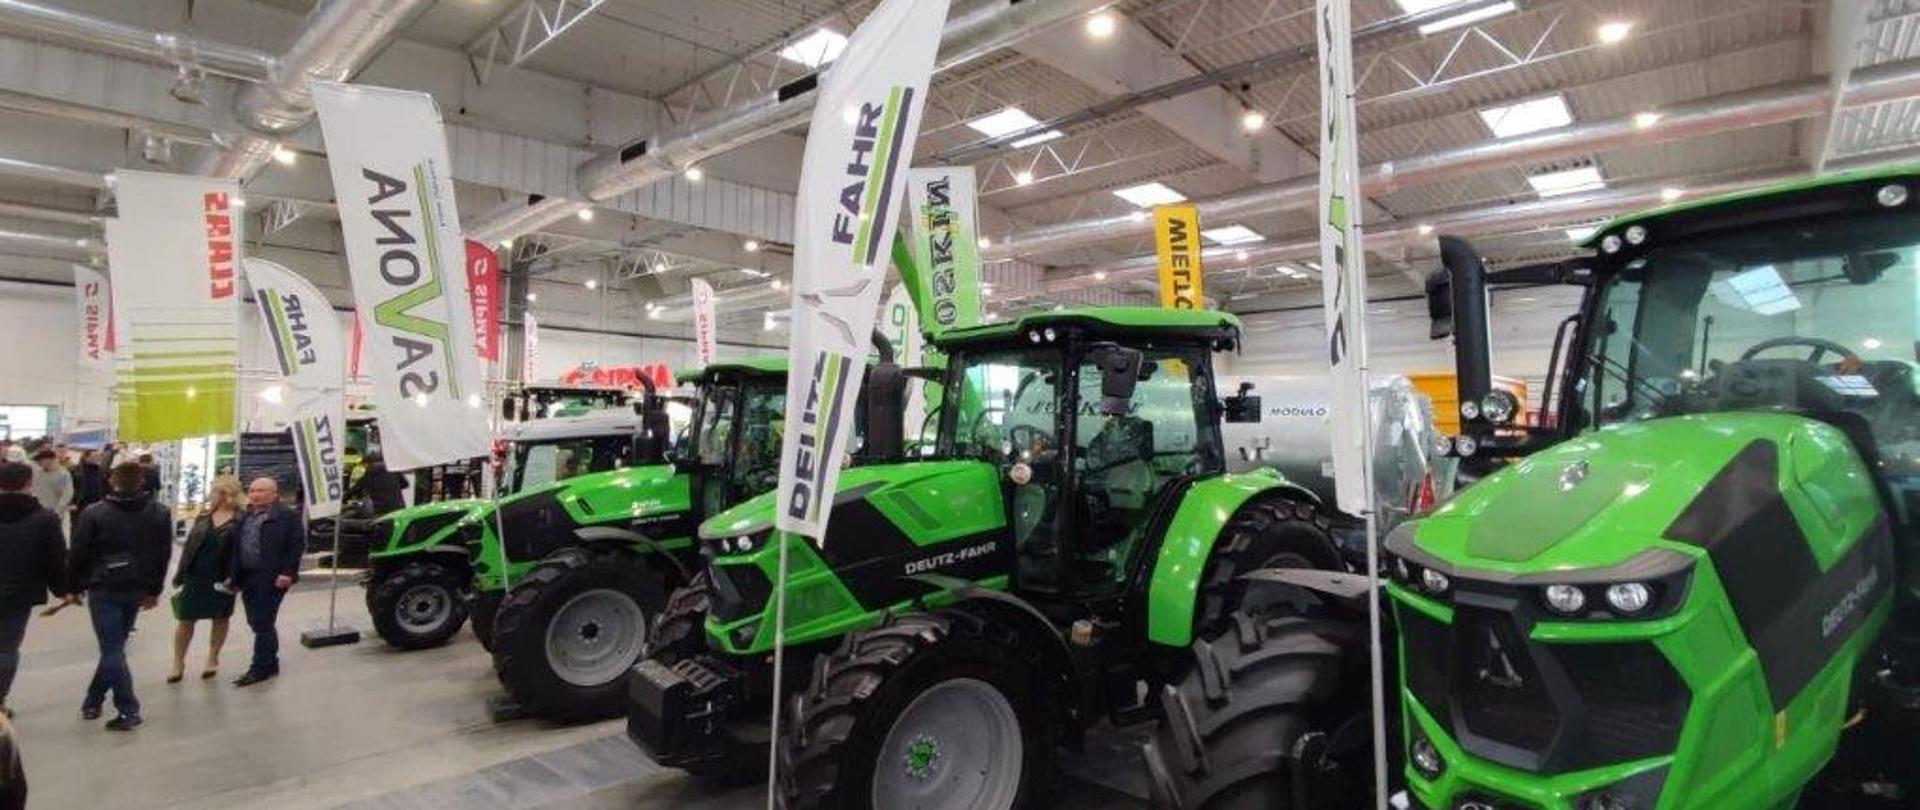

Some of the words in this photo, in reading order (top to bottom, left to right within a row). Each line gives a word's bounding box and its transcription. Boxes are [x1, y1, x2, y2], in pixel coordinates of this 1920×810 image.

[832, 101, 884, 245] FAHR
[1270, 406, 1328, 417] MODULO
[904, 540, 996, 574] DEUTZ-FAHR
